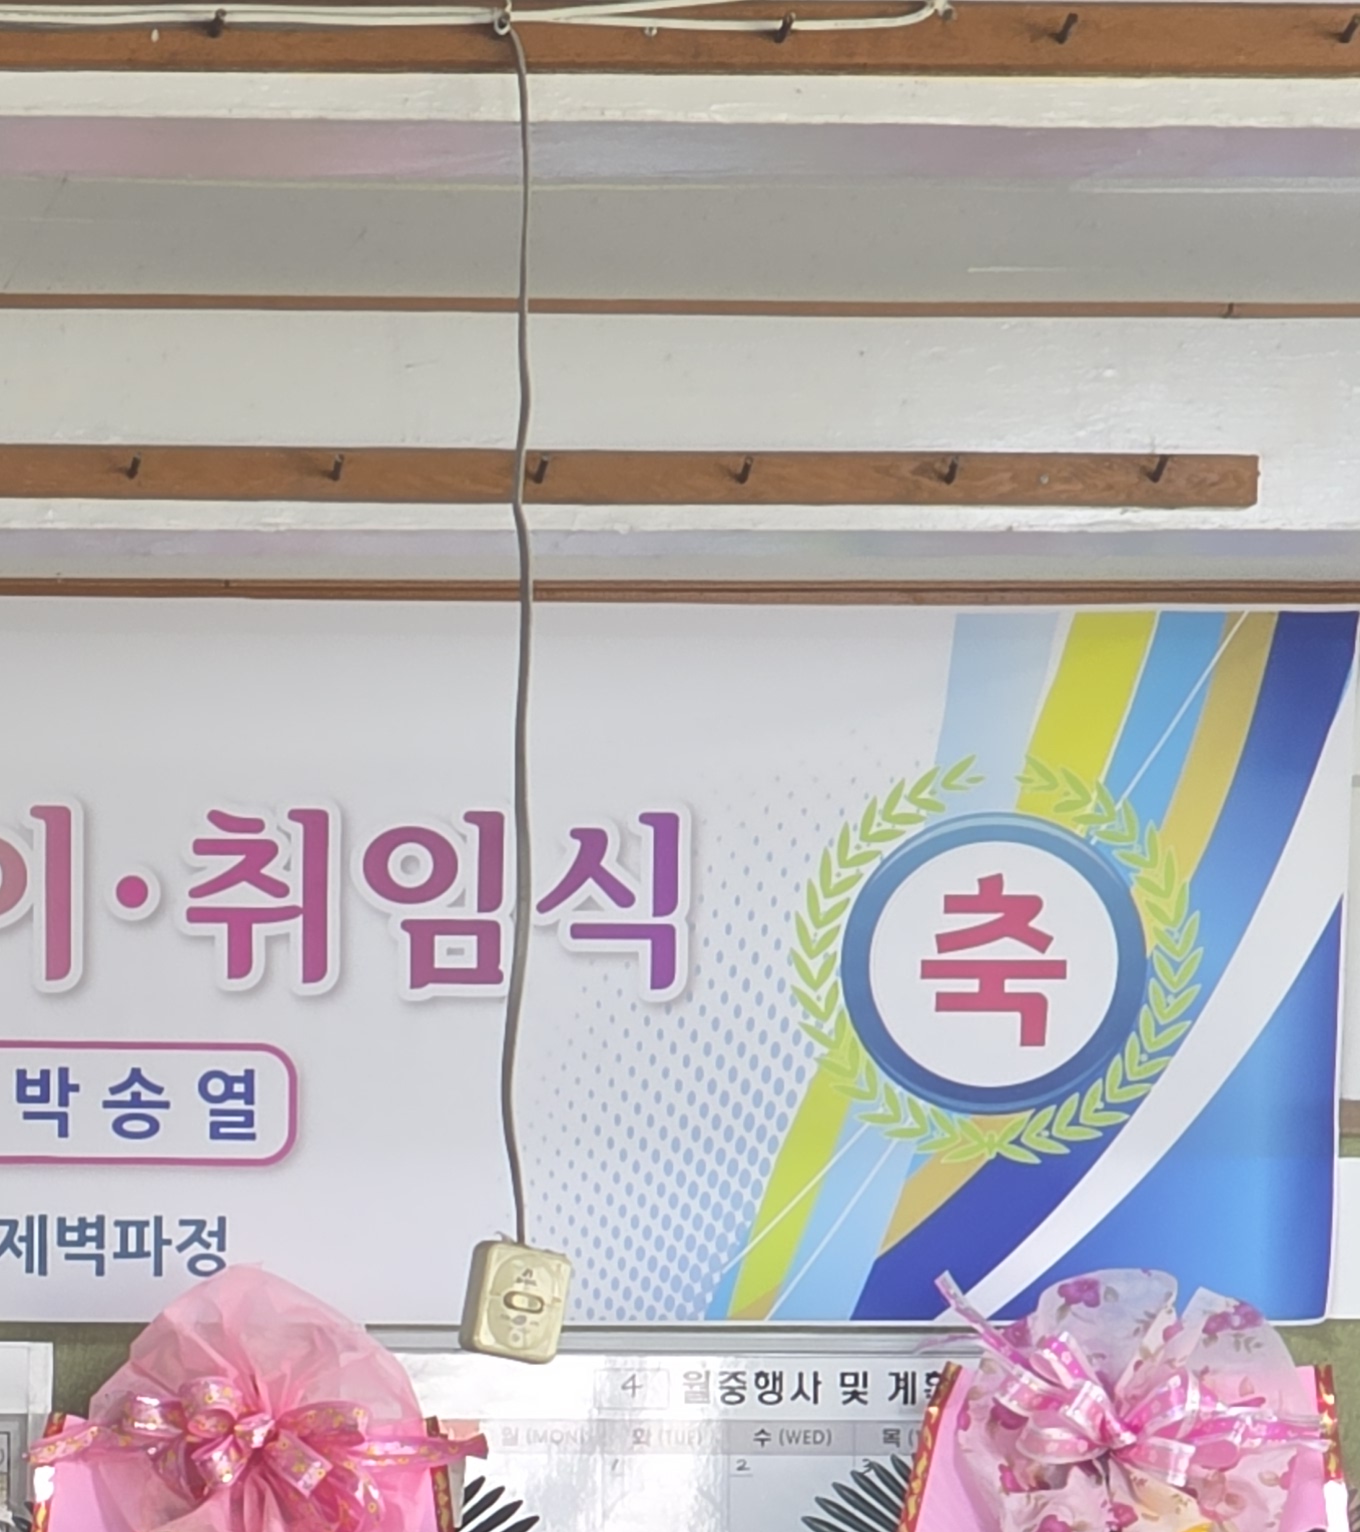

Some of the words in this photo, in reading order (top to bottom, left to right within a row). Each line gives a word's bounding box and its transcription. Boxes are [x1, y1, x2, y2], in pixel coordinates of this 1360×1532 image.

[920, 873, 1067, 1047] 축
[620, 1372, 644, 1400] 4
[682, 1369, 822, 1406] 월중행사
[838, 1370, 870, 1406] 및
[752, 1428, 773, 1447] 수
[779, 1428, 833, 1447] (WED)
[882, 1428, 902, 1447] 목
[736, 1459, 750, 1471] 2
